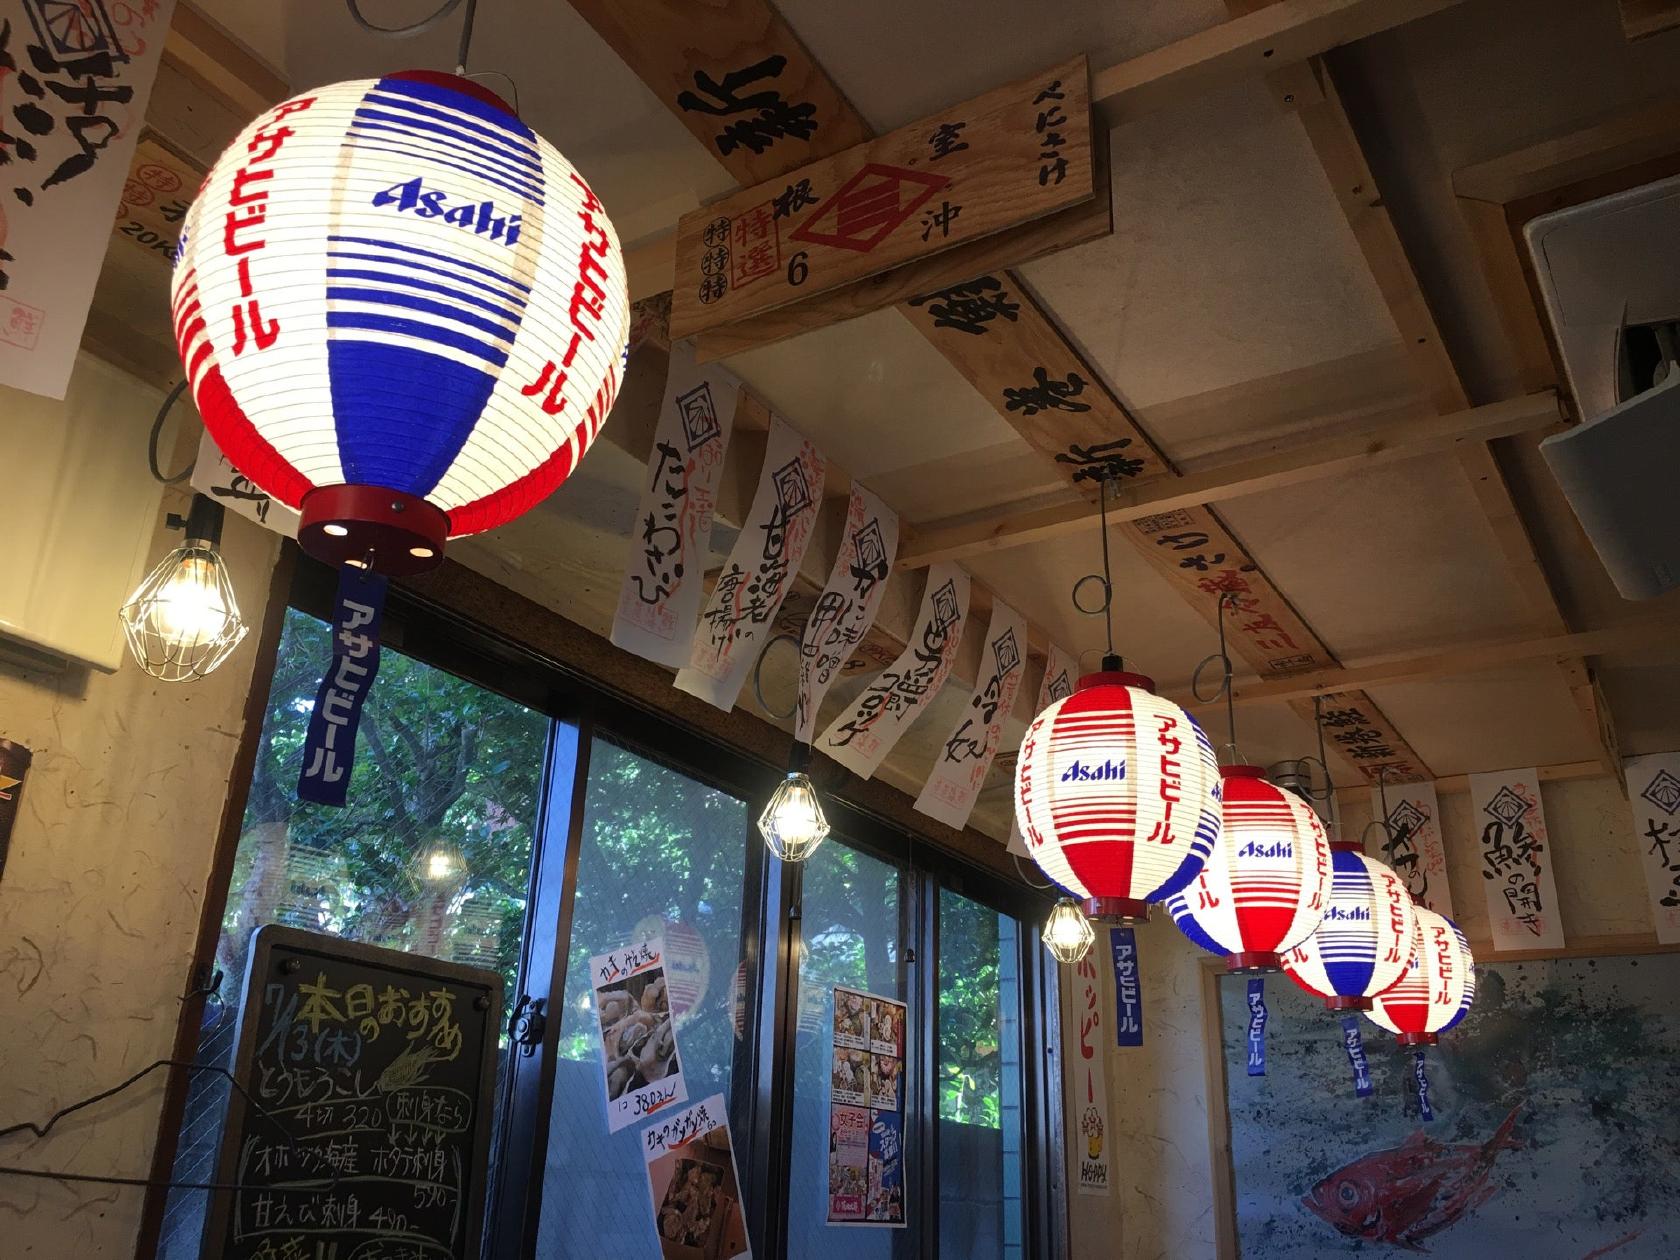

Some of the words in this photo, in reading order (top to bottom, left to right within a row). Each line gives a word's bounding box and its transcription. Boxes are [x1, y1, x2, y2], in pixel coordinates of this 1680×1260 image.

[1032, 80, 1070, 186] べにさけ
[223, 96, 317, 357] アサヒビール
[371, 176, 523, 246] Asahi
[735, 206, 777, 284] 特選
[921, 201, 963, 241] 沖
[520, 173, 611, 415] アサヒビール
[787, 252, 809, 286] 6
[304, 597, 376, 783] アサヒビール
[1020, 718, 1045, 848] アサヒビール
[1061, 759, 1126, 782] Asahi
[1146, 714, 1183, 845] アサヒビール
[1238, 840, 1293, 860] Asahi
[1299, 802, 1329, 910] アサヒビール
[1323, 906, 1370, 922] Asahi
[1380, 873, 1403, 963] アサヒビール
[1115, 944, 1139, 1034] アサヒビール
[1431, 926, 1452, 1006] アサヒビール
[293, 971, 463, 1061] 本日のおすすめ
[1248, 992, 1263, 1067] アサヒビール
[1347, 1028, 1370, 1090] アサヒビール
[342, 1104, 383, 1130] 320
